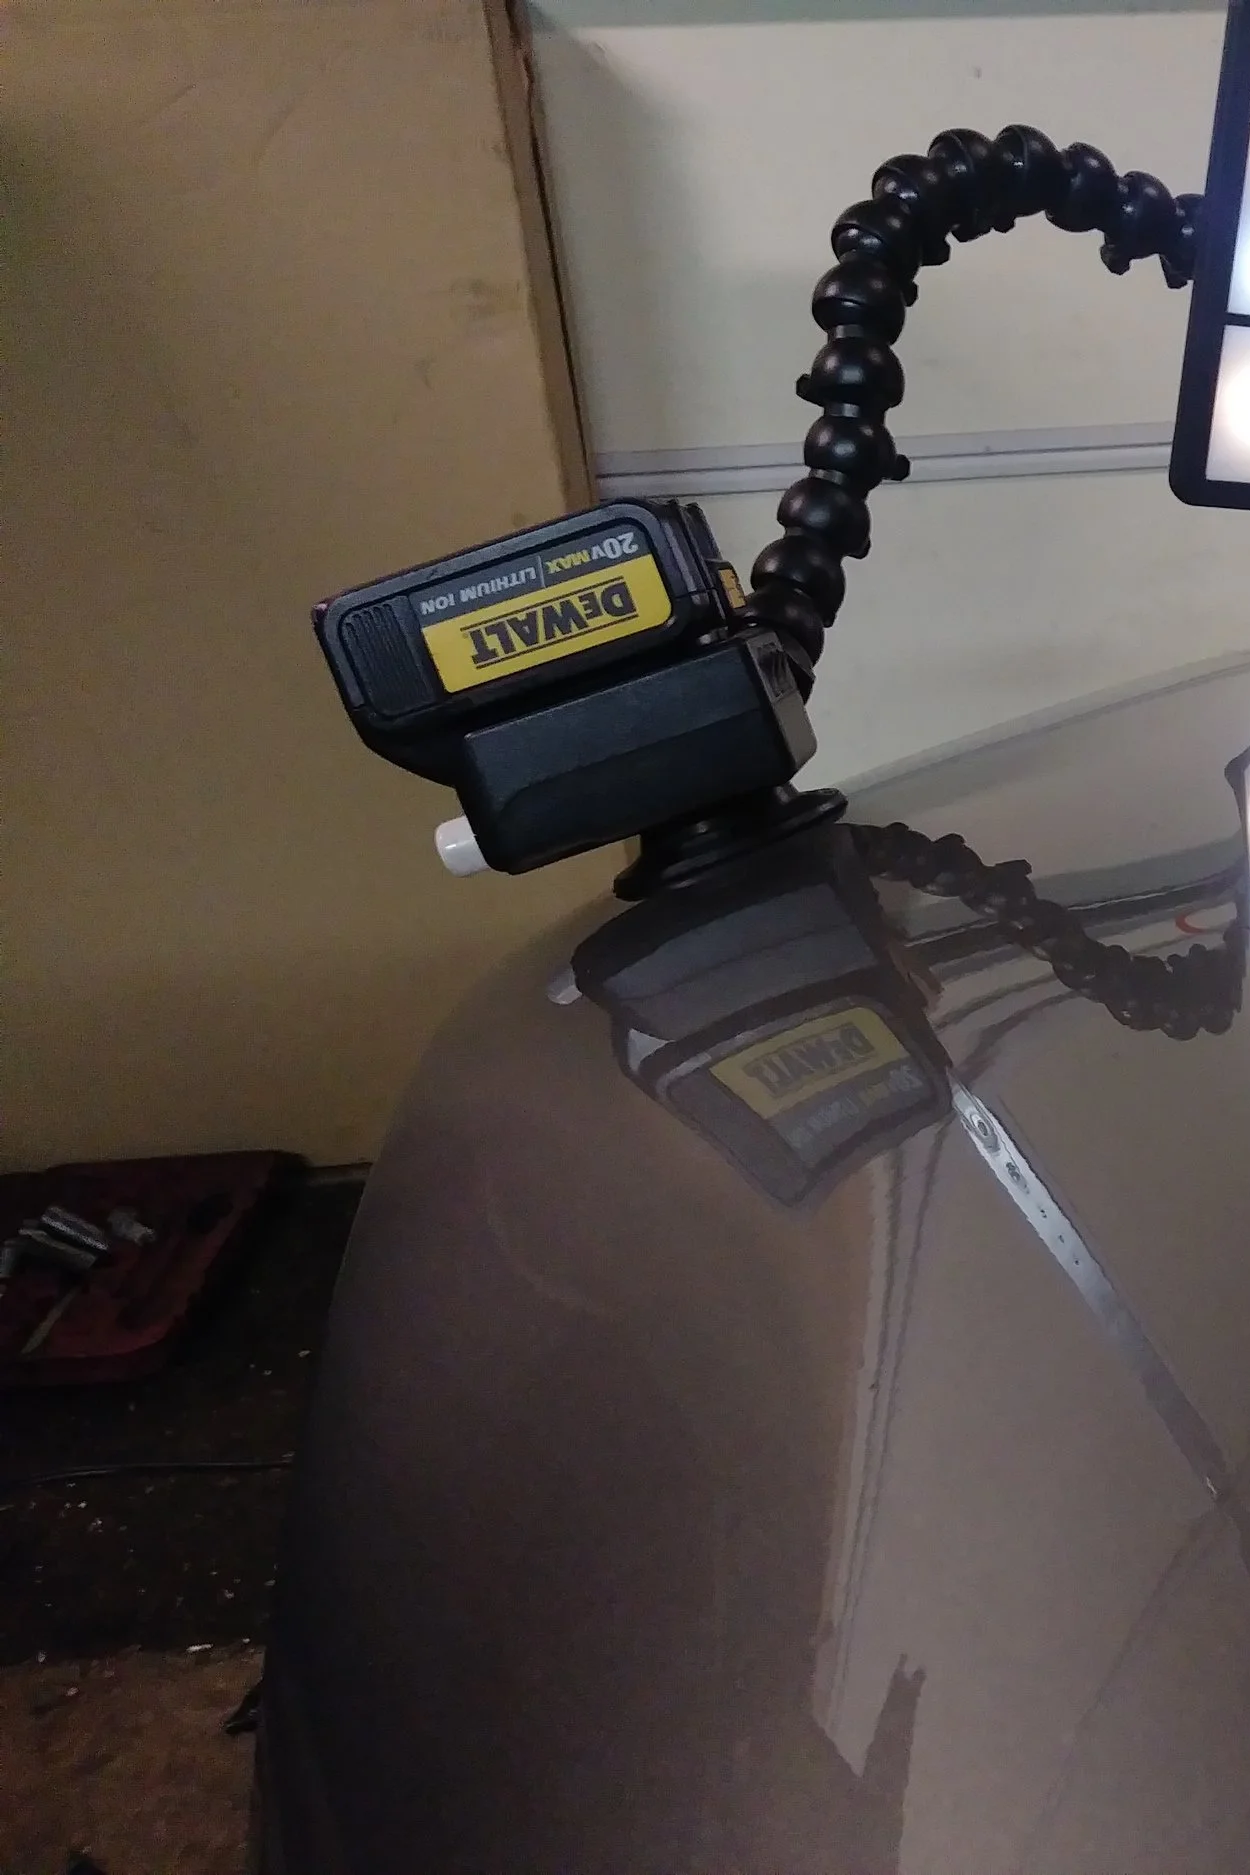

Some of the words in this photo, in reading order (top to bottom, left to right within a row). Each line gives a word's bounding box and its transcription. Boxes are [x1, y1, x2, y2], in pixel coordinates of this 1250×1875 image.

[545, 549, 590, 575] MAX
[459, 567, 537, 603] LITHIUM
[419, 593, 455, 615] ION
